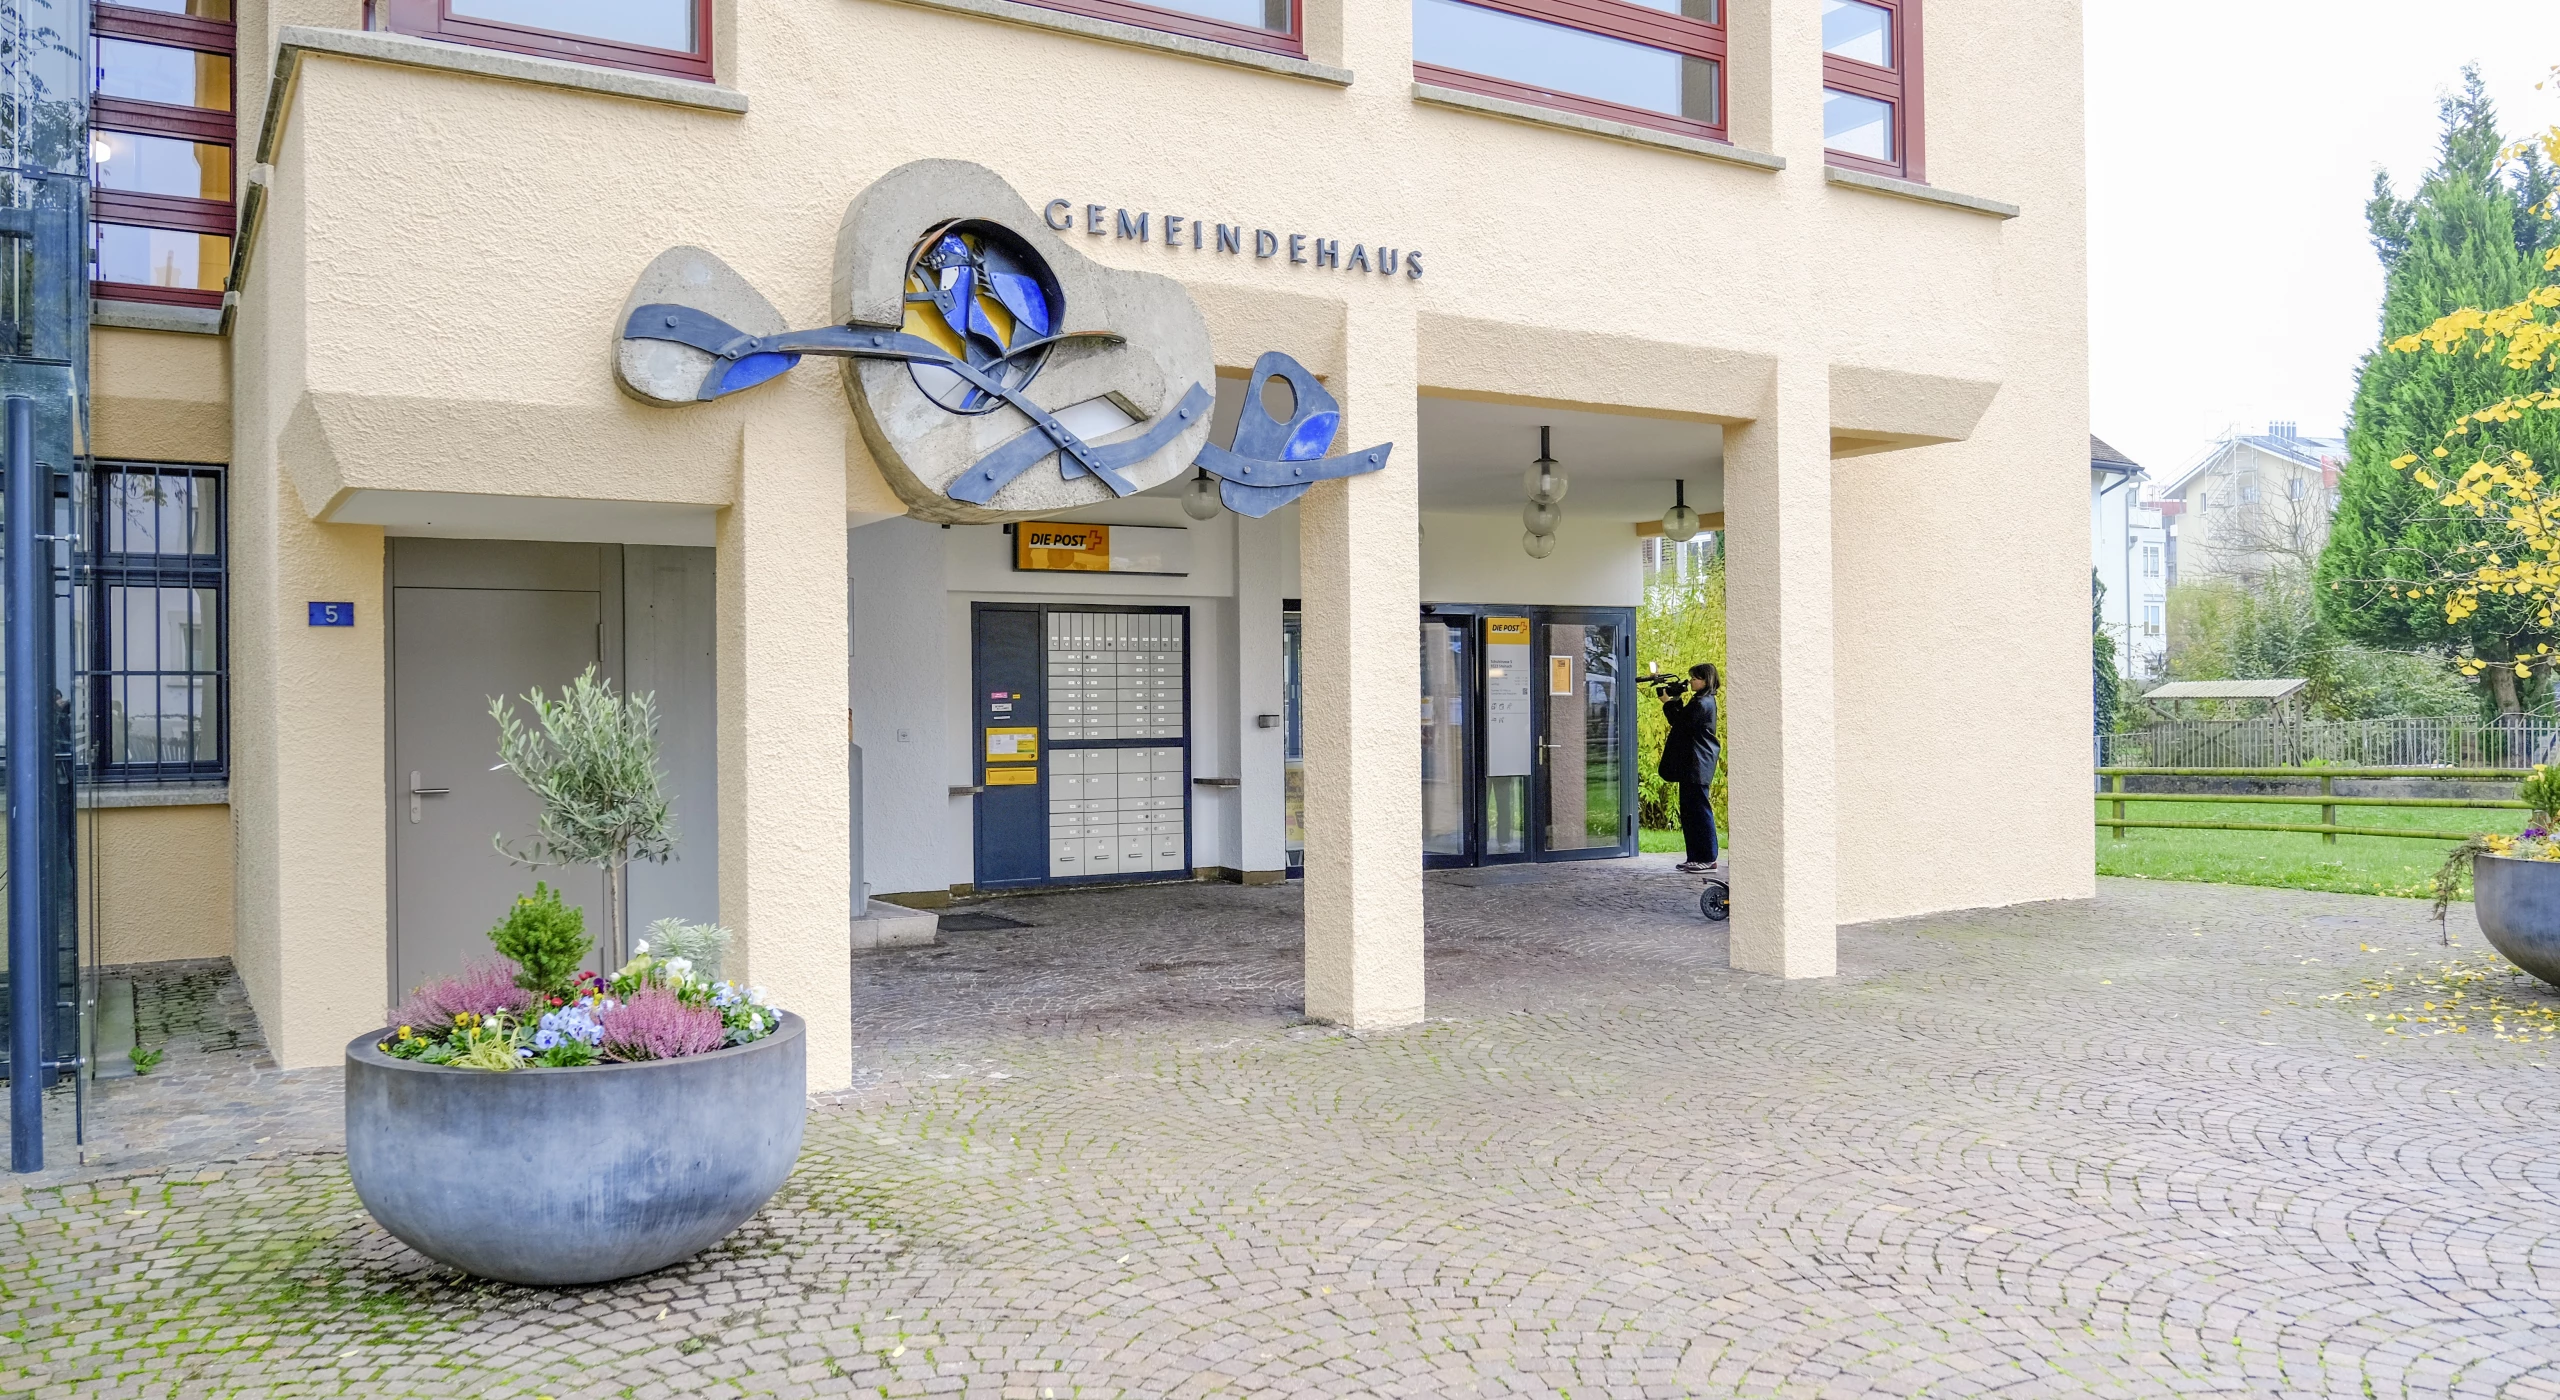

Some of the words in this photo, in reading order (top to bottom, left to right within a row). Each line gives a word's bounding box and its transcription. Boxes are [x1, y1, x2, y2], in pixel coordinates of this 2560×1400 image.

[1043, 198, 1424, 280] GEMEINDEHAUS
[1030, 533, 1052, 546] DIE
[1053, 534, 1087, 547] POST
[325, 605, 339, 623] 5
[1492, 624, 1503, 632] DIE
[1503, 624, 1520, 632] POST
